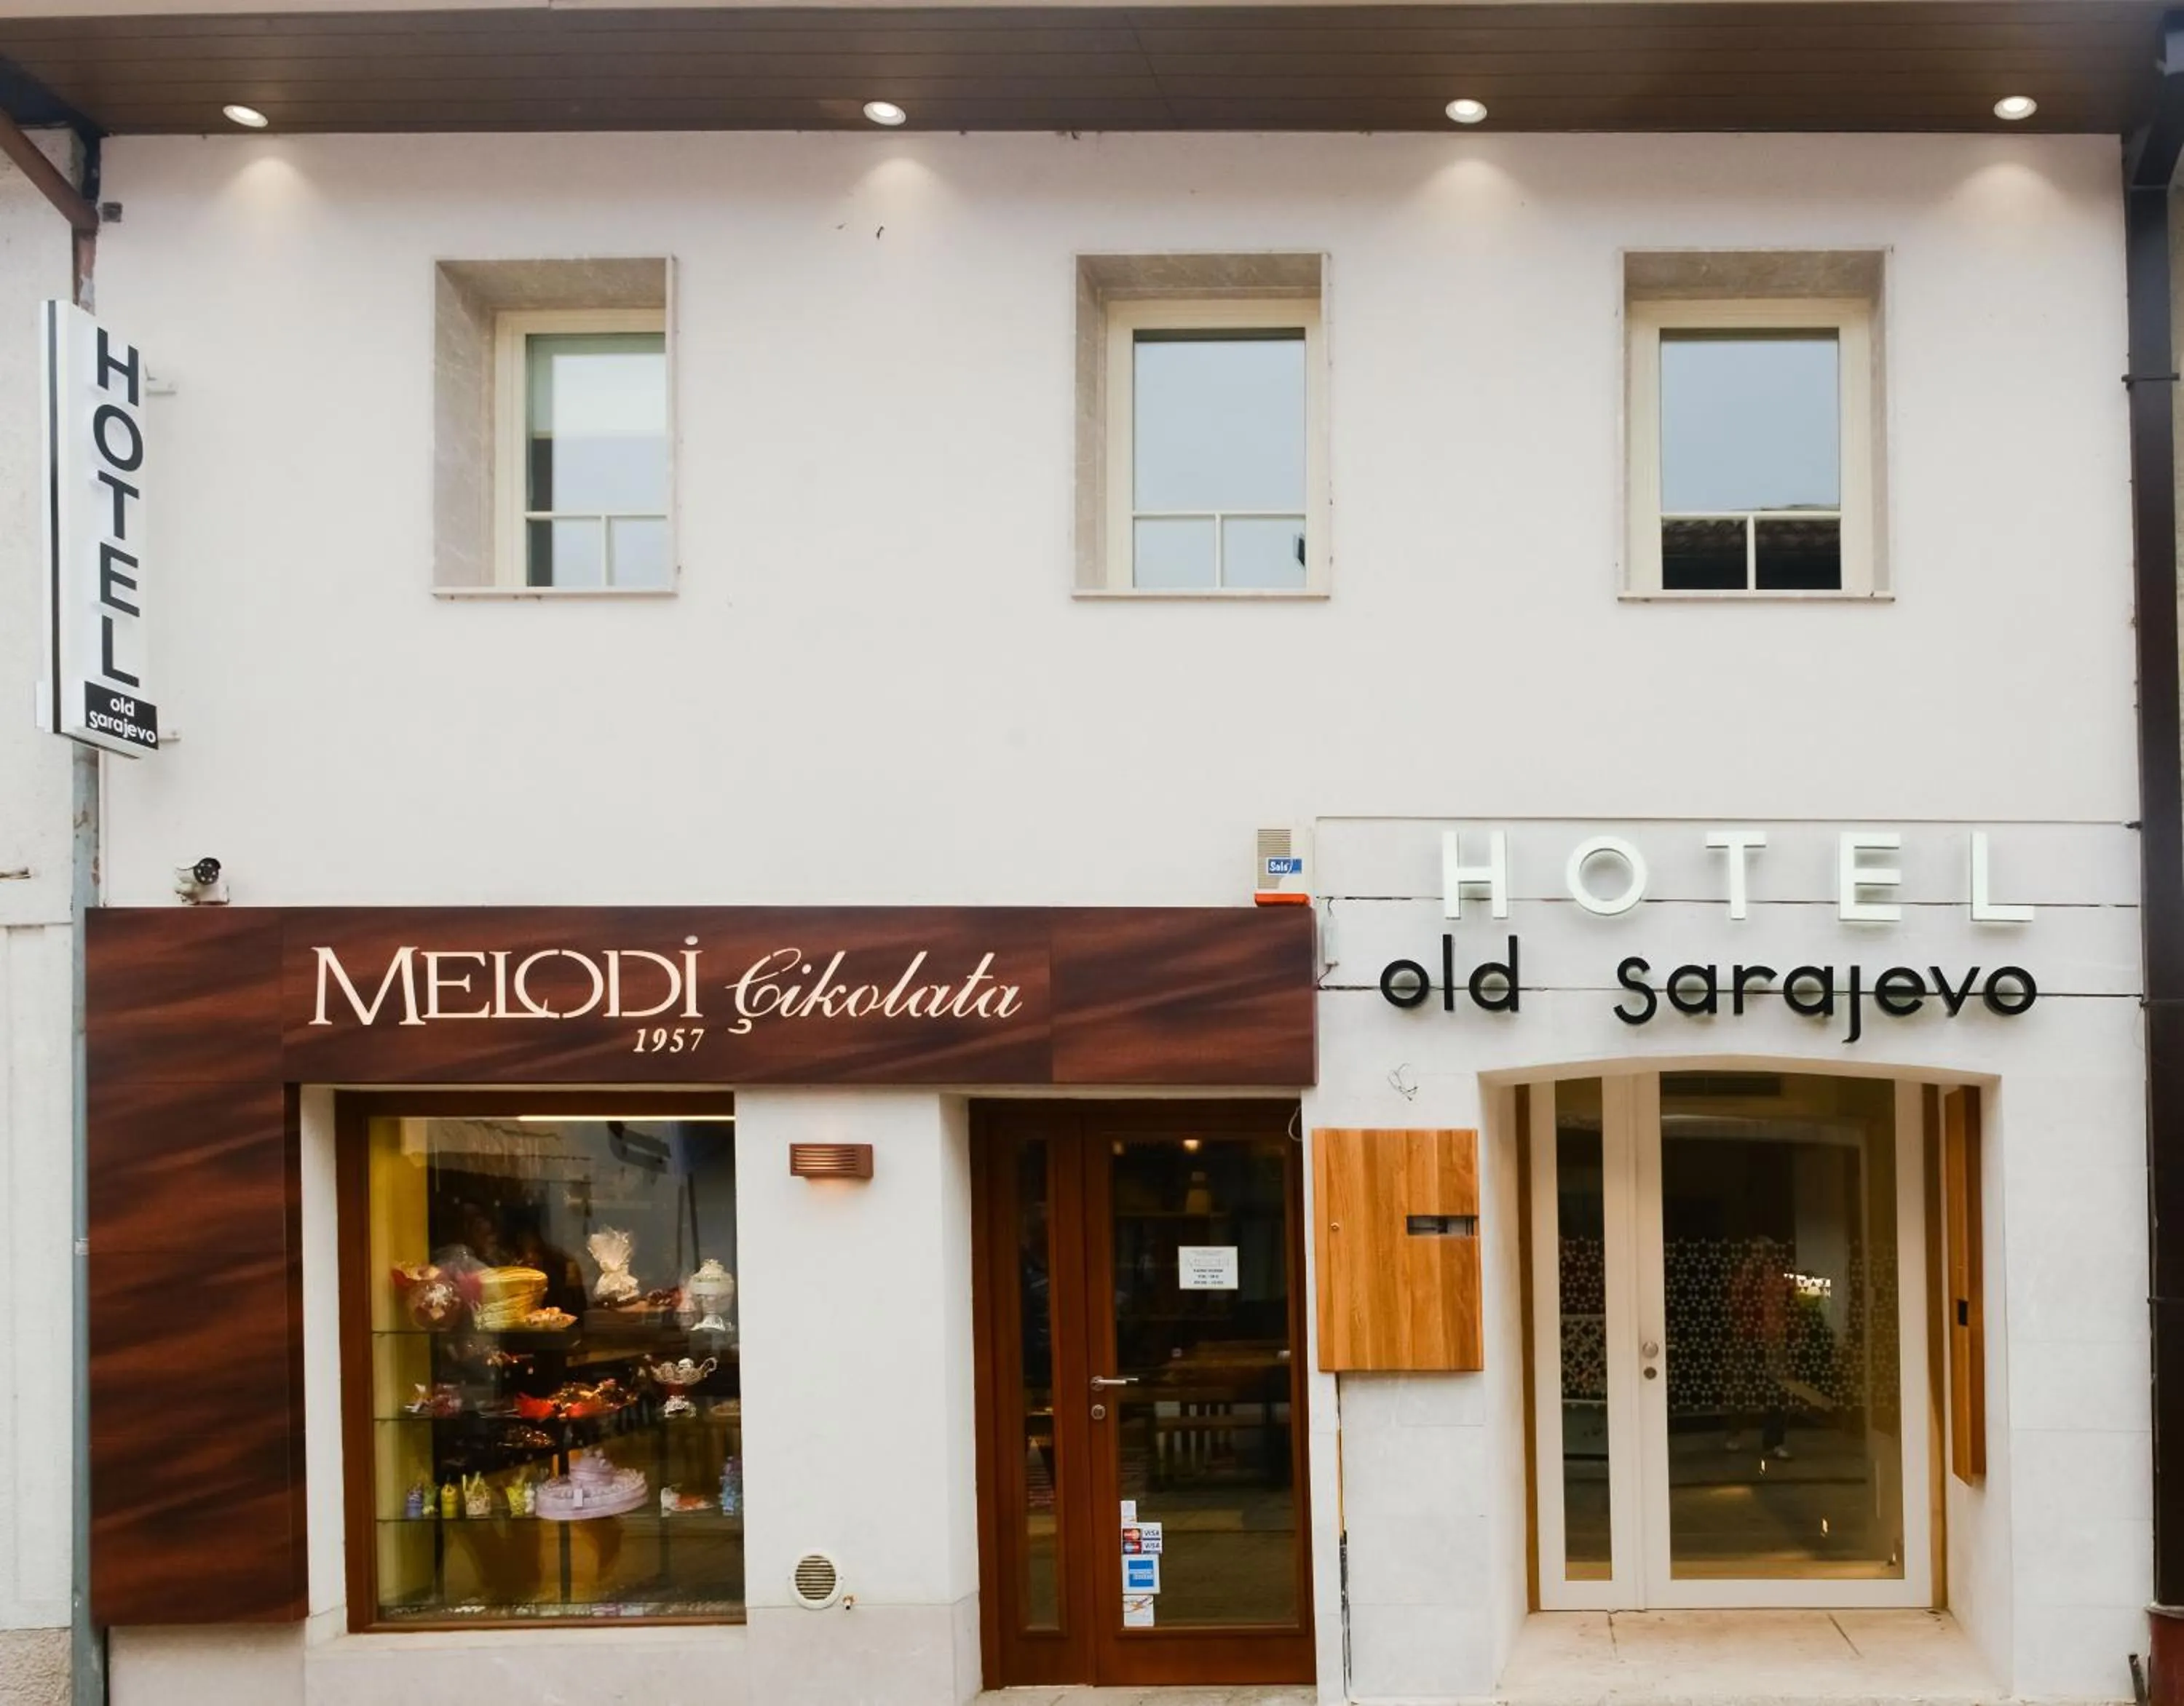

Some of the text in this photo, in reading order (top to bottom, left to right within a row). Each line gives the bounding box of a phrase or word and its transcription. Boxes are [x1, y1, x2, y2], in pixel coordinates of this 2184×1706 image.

[92, 327, 143, 688] HOTEL
[110, 697, 135, 717] old
[1441, 830, 2035, 922] HOTEL
[725, 948, 1022, 1034] Çikolata
[1380, 934, 1520, 1013] old
[633, 1028, 705, 1053] 1957
